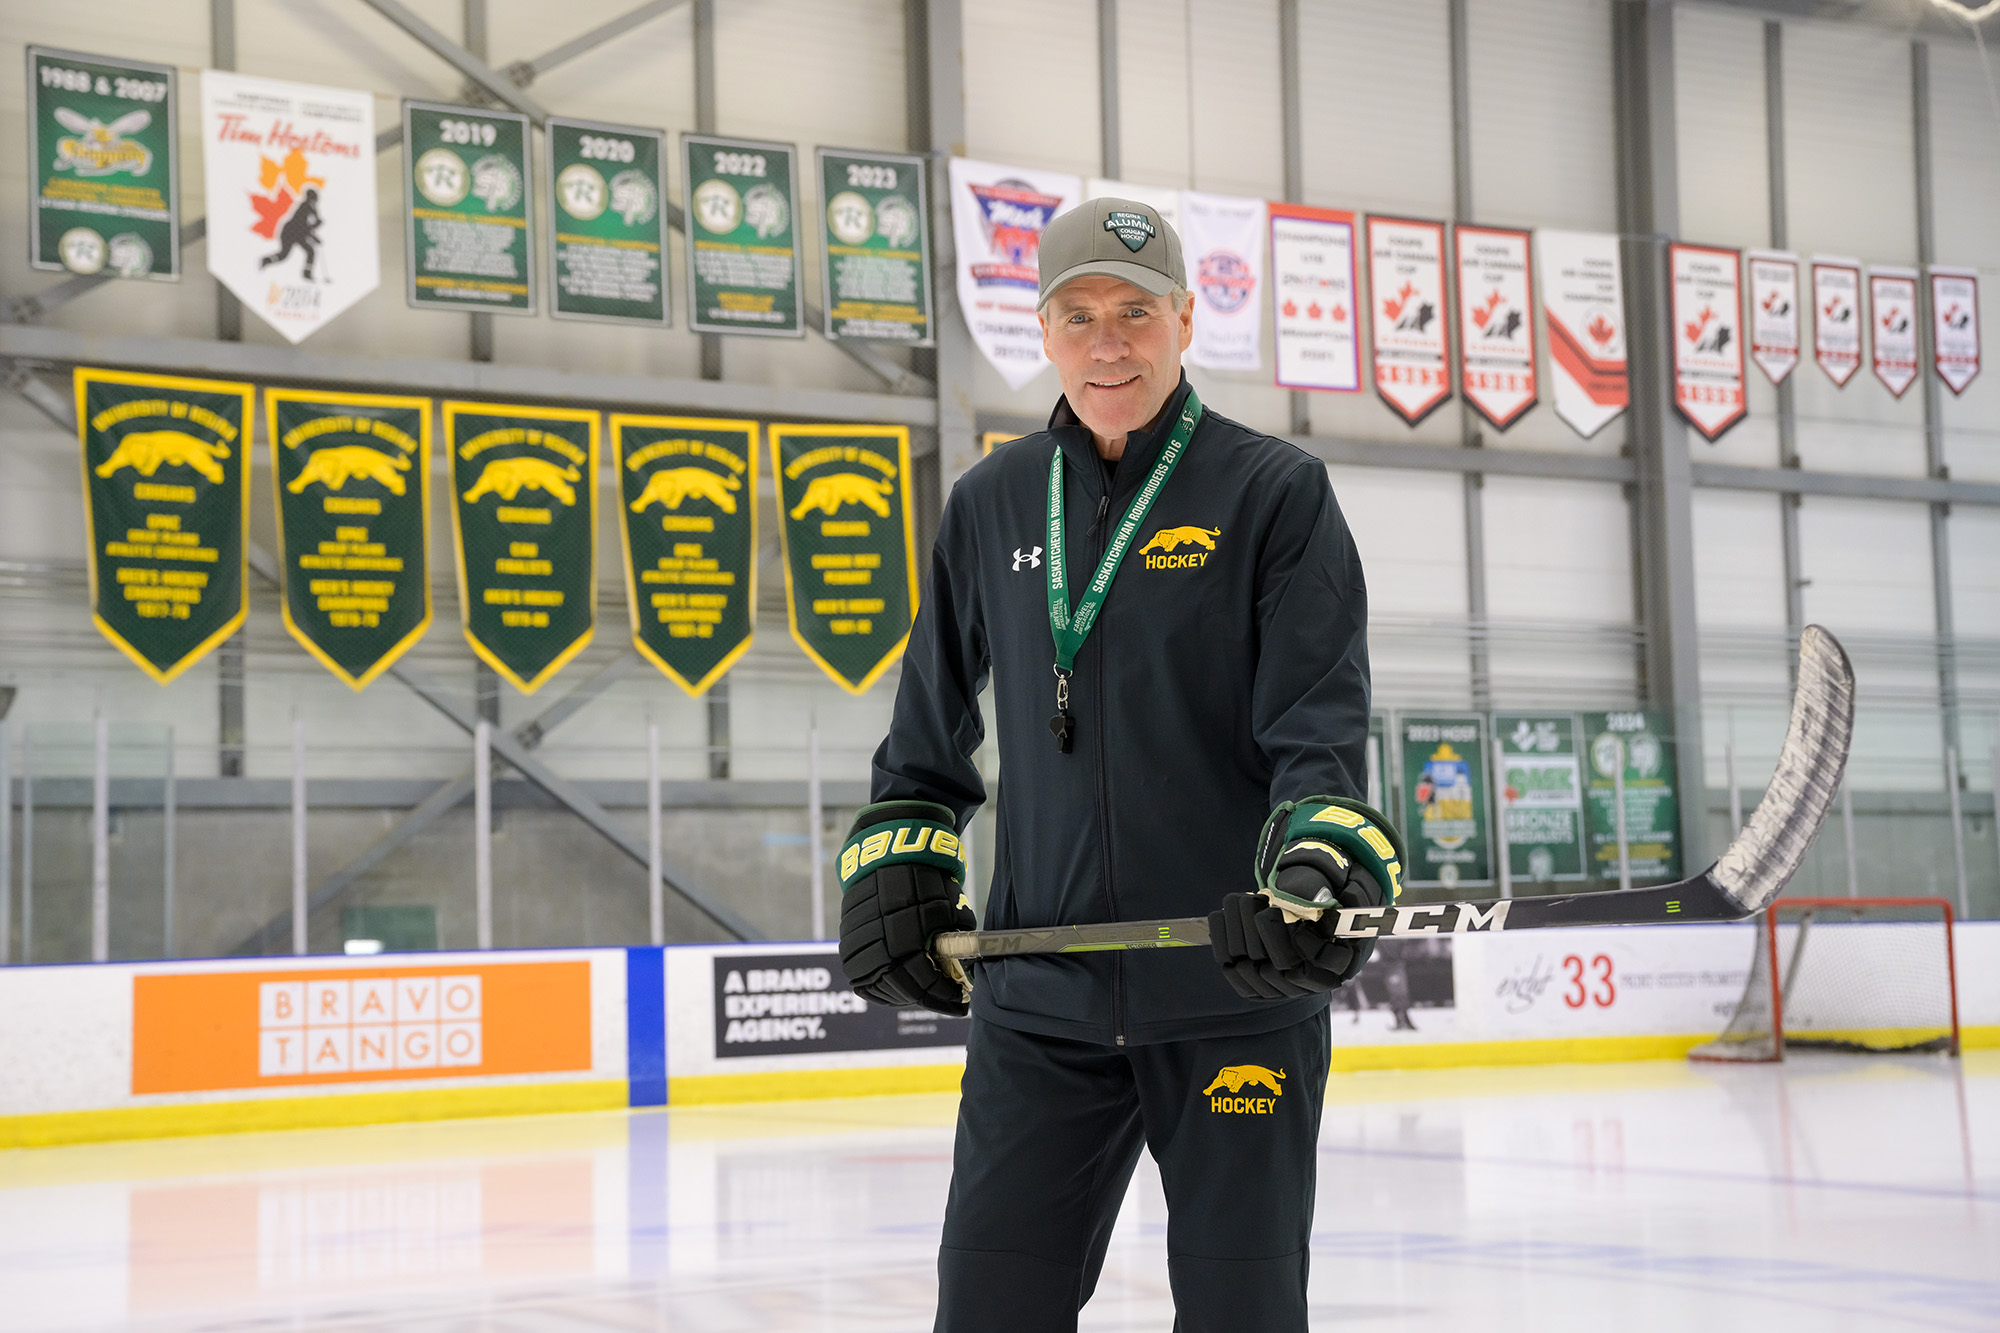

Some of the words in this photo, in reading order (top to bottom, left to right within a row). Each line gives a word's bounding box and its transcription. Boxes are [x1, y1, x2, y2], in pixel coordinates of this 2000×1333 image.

[41, 65, 92, 93] 1988
[95, 76, 112, 96] &
[114, 77, 168, 103] 2007
[218, 113, 262, 145] Tim
[267, 120, 361, 158] Hortons
[440, 119, 497, 148] 2019
[579, 135, 636, 164] 2020
[714, 152, 767, 178] 2022
[847, 164, 898, 190] 2023
[1107, 219, 1154, 234] ALUMNI
[1120, 228, 1145, 237] COUGAR
[1050, 457, 1061, 517] ROUGHRIDERS
[1092, 520, 1136, 594] SASKATCHEWAN
[1130, 463, 1169, 522] ROUGHRIDERS
[1162, 439, 1182, 465] 2016
[1050, 517, 1063, 589] SASKATCHEWAN
[1145, 553, 1208, 570] HOCKEY
[1334, 900, 1512, 939] CCM
[724, 970, 745, 993] A
[747, 967, 831, 992] BRAND
[1496, 956, 1552, 1014] eight
[1563, 954, 1616, 1008] 33
[275, 983, 473, 1019] BRAVO
[724, 991, 868, 1019] EXPERIENCE
[724, 1017, 826, 1044] AGENCY.
[275, 1028, 473, 1065] TANGO
[1211, 1097, 1276, 1114] HOCKEY
